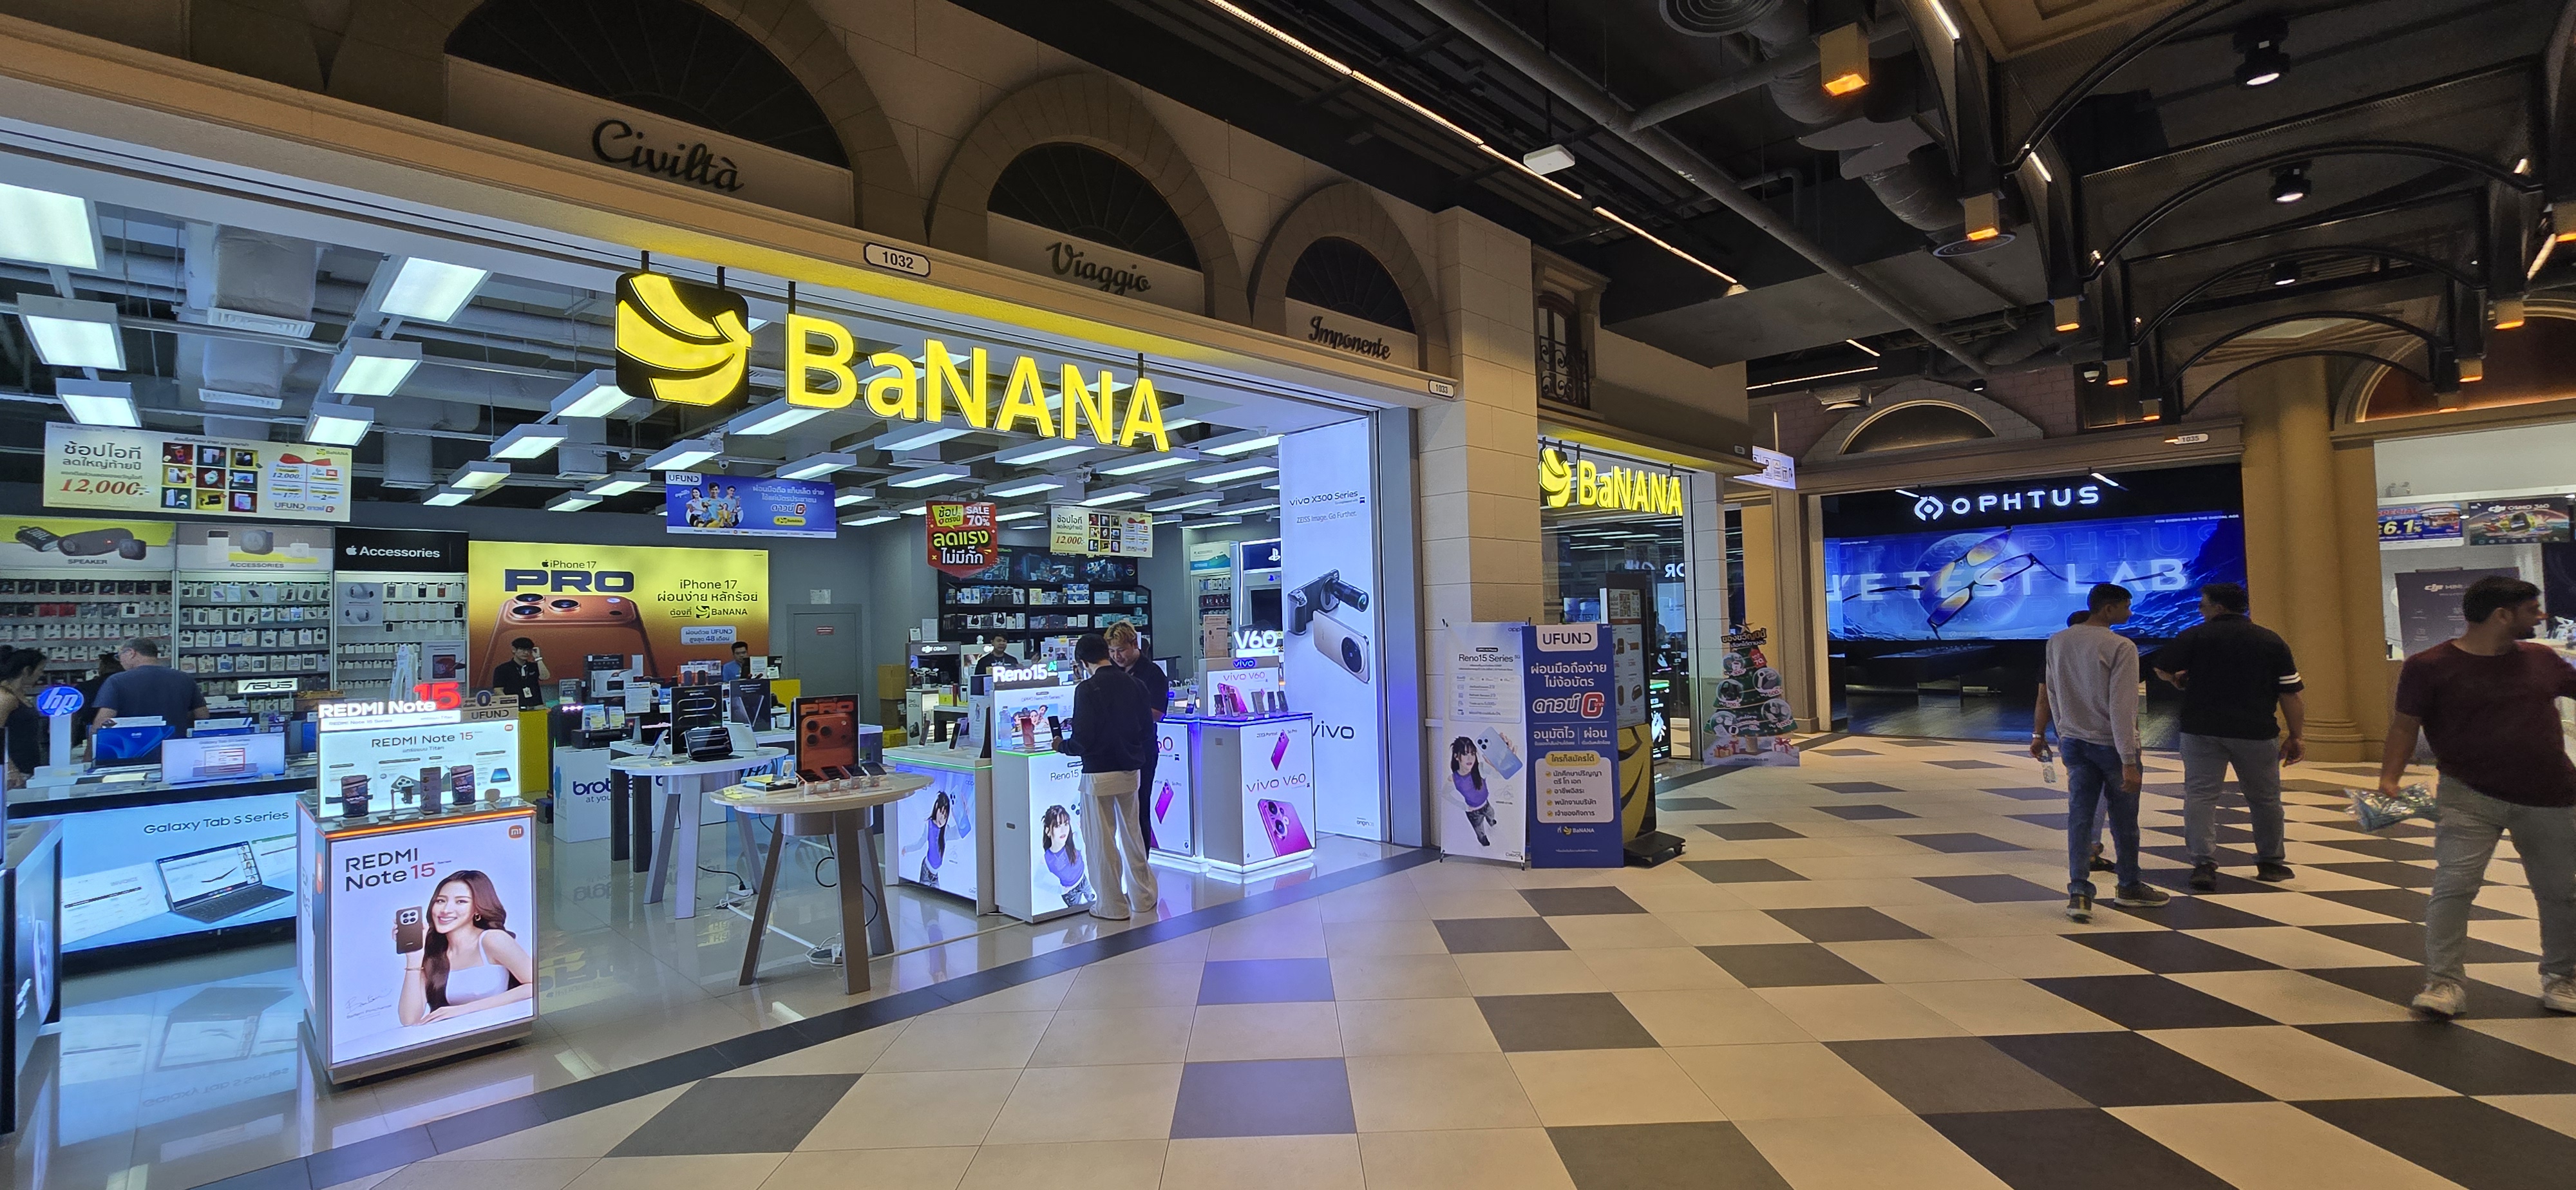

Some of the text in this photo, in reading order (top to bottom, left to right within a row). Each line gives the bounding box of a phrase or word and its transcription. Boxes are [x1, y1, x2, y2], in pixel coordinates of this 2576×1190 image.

[592, 119, 744, 192] Civiltà
[882, 250, 914, 270] 1032
[1046, 241, 1151, 296] Viaggio
[1308, 315, 1391, 360] Imponente
[786, 313, 1170, 453] BaNANA
[1435, 384, 1448, 394] 1033
[64, 441, 141, 459] ช้อปไอที
[62, 457, 141, 469] ลดใหญ่ท้ายปี
[668, 474, 699, 483] UFUND
[1578, 459, 1683, 516] BaNANA
[1289, 498, 1310, 506] vivo
[1311, 494, 1332, 503] X300
[1334, 491, 1358, 500] Series
[1951, 485, 2099, 515] OPHTUS
[939, 505, 958, 517] ช้อป
[966, 506, 989, 515] SALE
[2488, 505, 2506, 513] dji
[967, 515, 990, 526] 70%
[1057, 515, 1083, 524] ช้อปไอที
[934, 531, 989, 547] ลดแรง
[359, 546, 440, 558] Accessories
[941, 545, 983, 564] ไม่มีกั๊ก
[550, 560, 585, 569] iPhone
[505, 569, 634, 593] PRO
[2067, 558, 2186, 594] LAB
[680, 580, 737, 589] iPhone 17
[658, 590, 758, 601] ผ่อนง่าย หลักร้อย
[1233, 630, 1278, 649] V60
[1542, 632, 1592, 645] UFUND
[992, 663, 1048, 683] Reno15
[1531, 661, 1607, 674] ผ่อนมือถือง่าย
[243, 681, 292, 690] ASUS
[1544, 675, 1595, 688] ไม่ง้อบัตร
[44, 686, 78, 715] hp
[413, 682, 462, 710] 15
[1533, 693, 1582, 713] ดาวน์
[319, 701, 437, 718] REDMI Note
[471, 710, 509, 719] UFUND
[800, 701, 854, 715] PRO
[372, 732, 473, 747] REDMI Note 15
[1533, 726, 1575, 742] อนุมัติไว
[1584, 727, 1607, 738] ผ่อน
[1551, 753, 1595, 762] ใครก็สมัครได้
[1050, 769, 1079, 781] Reno15
[1246, 773, 1306, 792] vivo V60
[143, 811, 289, 835] Galaxy Tab S Series
[346, 847, 418, 873] REDMI
[346, 868, 408, 892] Note
[410, 862, 436, 880] 15
